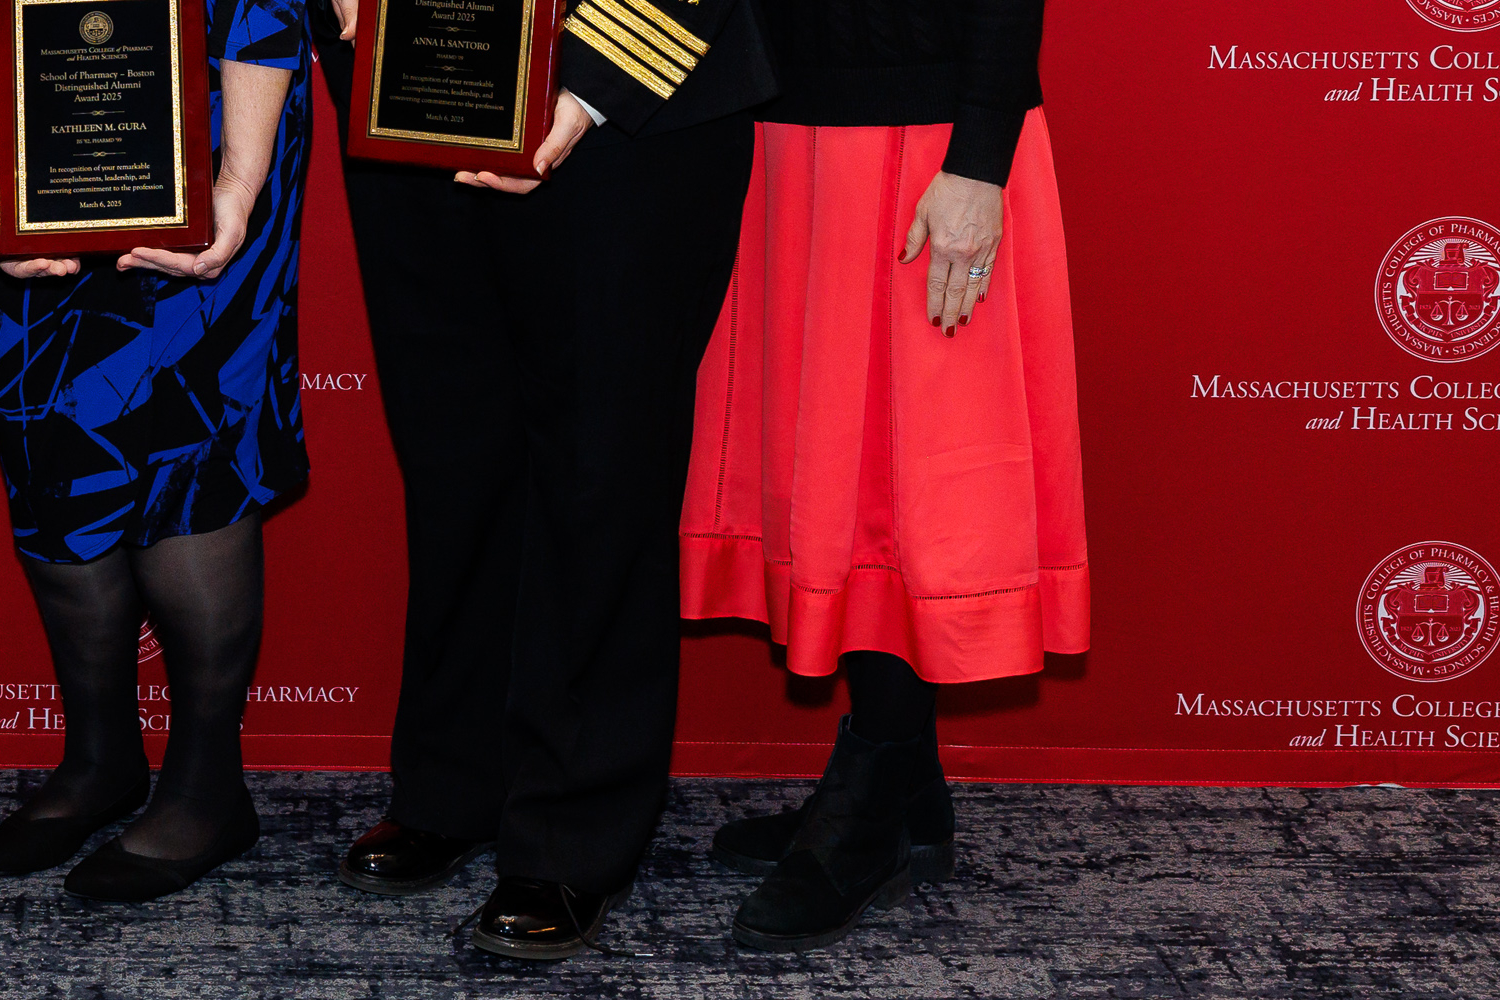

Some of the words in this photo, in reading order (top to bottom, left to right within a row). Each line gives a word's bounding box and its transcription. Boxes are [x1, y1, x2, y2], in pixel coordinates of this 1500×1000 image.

[466, 1, 494, 12] Alumni
[431, 11, 455, 20] Award
[456, 12, 475, 22] 2025
[88, 46, 115, 54] COLLEGE
[412, 37, 438, 47] ANNA
[447, 40, 490, 51] SANTORO
[40, 72, 67, 81] School
[69, 72, 79, 80] of
[79, 71, 118, 80] Pharmacy
[127, 69, 155, 78] Boston
[54, 81, 109, 93] Distinguished
[110, 81, 141, 90] Alumni
[74, 93, 100, 103] Award
[101, 92, 122, 101] 2025
[425, 113, 443, 121] March
[450, 115, 464, 123] 2025
[51, 124, 103, 134] KATHLEEN
[104, 123, 116, 132] M.
[117, 122, 147, 131] GURA
[58, 165, 92, 174] recognition
[93, 164, 101, 172] of
[116, 162, 150, 170] remarkable
[50, 175, 104, 184] accomplishments,
[104, 173, 138, 182] leadership,
[37, 187, 72, 195] unwavering
[132, 183, 164, 192] profession
[79, 200, 99, 208] March
[99, 200, 106, 208] 6,
[107, 200, 122, 208] 2025
[1175, 693, 1381, 717] MASSACHUSETTS
[1289, 729, 1326, 747] and
[1335, 725, 1434, 747] HEALTH
